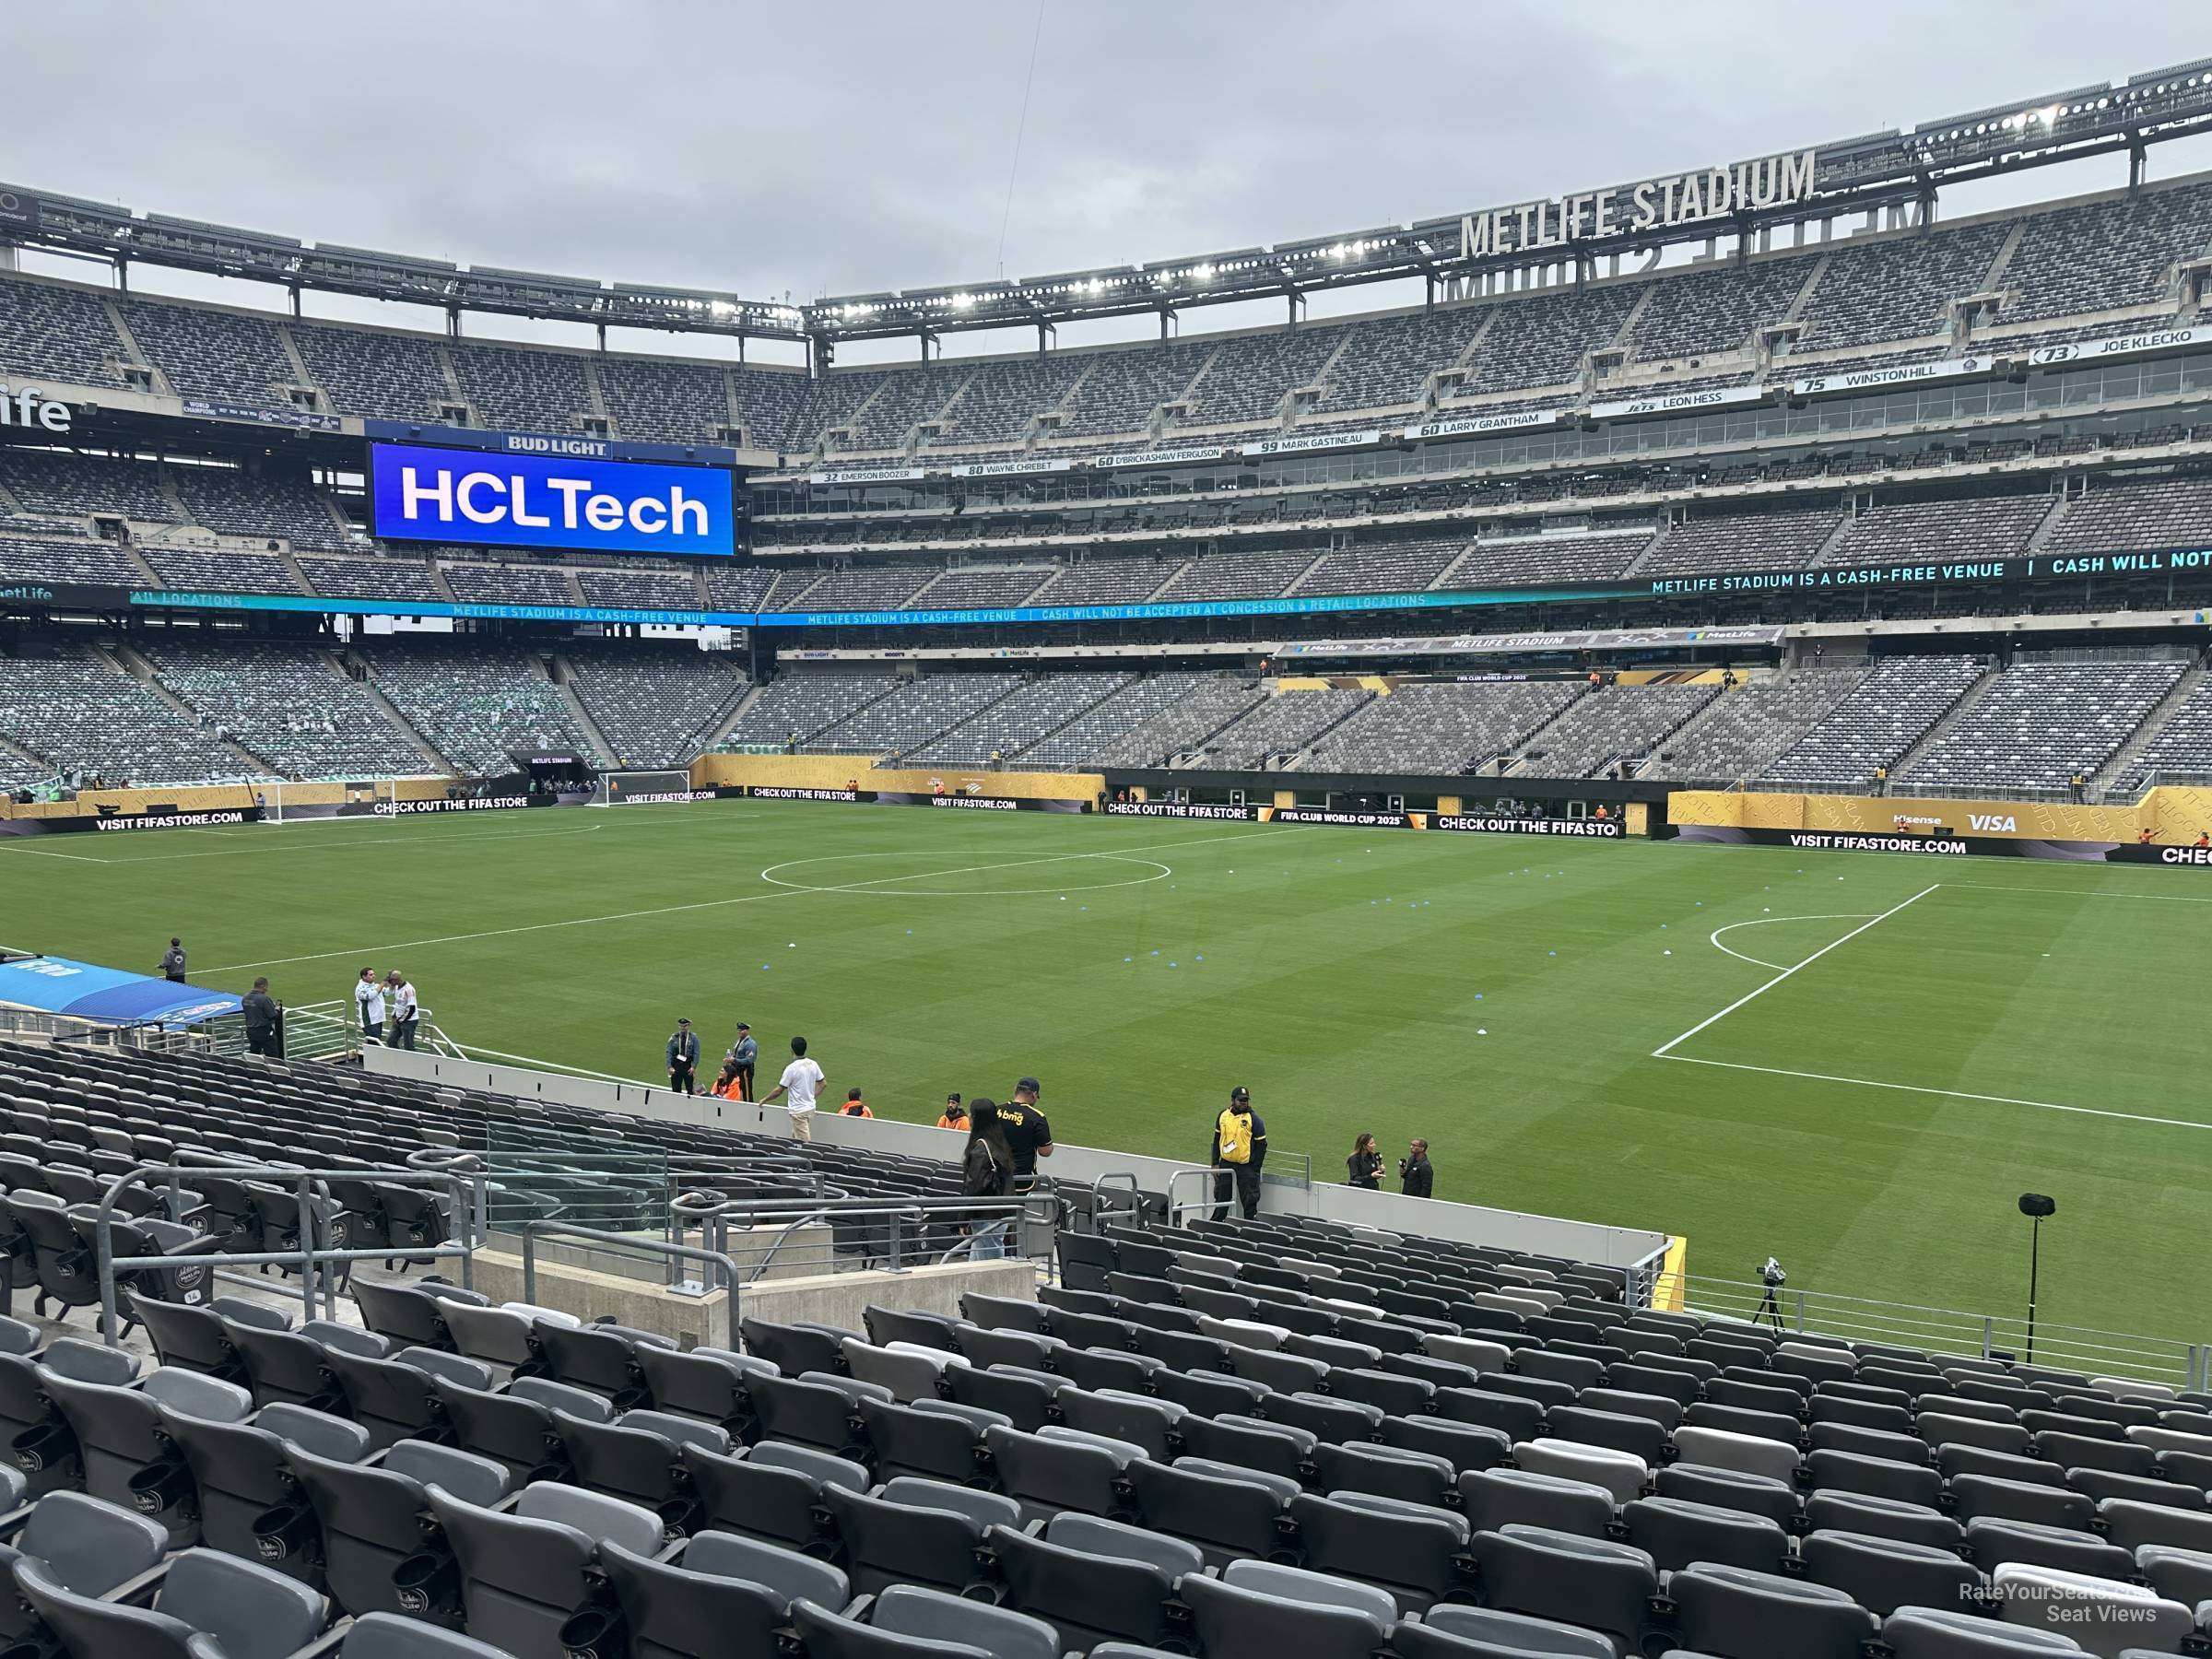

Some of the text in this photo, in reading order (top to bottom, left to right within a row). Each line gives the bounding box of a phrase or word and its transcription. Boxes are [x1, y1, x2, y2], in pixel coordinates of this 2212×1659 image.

[1461, 190, 1617, 258] METLIFE
[1632, 150, 1816, 228] STADIUM
[2043, 330, 2192, 360] 73 JOE KLECKO
[1804, 365, 1936, 392] 75 WINSTON HILL
[1663, 396, 1691, 409] LEON
[1693, 392, 1723, 405] HESS
[1420, 413, 1539, 436] 60 LARRY GRANTHAM
[508, 436, 606, 457] BUD LIGHT
[1261, 434, 1362, 453] 99 MARK GASTINEAU
[1098, 448, 1219, 466] 60 D'BRICKASHAW FERGUSON
[824, 470, 910, 482] 32 EMERSON BOOZER
[969, 462, 1052, 476] 80 WAYNE CHREBET
[402, 466, 708, 535] HCLTech
[1653, 550, 2212, 594] METLIFE STADIUM IS A CASH-FREE VENUE CASH WILL NOT
[161, 593, 241, 606] LOCATIONS
[453, 605, 707, 624] METLIFE STADIUM IS A CASH-FREE VENUE
[808, 614, 851, 624] METLIFE
[853, 613, 897, 624] STADIUM
[900, 613, 909, 623] IS
[912, 613, 920, 622] A
[922, 611, 979, 622] CASH-FREE
[982, 610, 1017, 621] VENUE
[1041, 609, 1069, 620] CASH
[1071, 607, 1099, 619] WILL
[1101, 606, 1124, 618] NOT
[1127, 606, 1141, 617] BE
[1143, 604, 1200, 617] ACCEPTED
[1204, 603, 1218, 613] AT
[1220, 599, 1294, 614] CONCESSION
[1310, 597, 1353, 612] RETAIL
[1356, 594, 1425, 608] LOCATIONS
[1452, 636, 1565, 648] METLIFE STADIUM
[1707, 629, 1756, 639] MetLife
[1311, 644, 1347, 653] MetLife
[625, 791, 715, 803] VISIT FIFASTORE.COM
[754, 788, 855, 801] CHECK OUT THE FIFA STORE
[374, 797, 527, 814] CHECK OUT THE FIFA STORE
[932, 798, 1017, 809] VISIT FIFASTORE.COM
[1108, 803, 1247, 819] CHECK OUT THE FIFA STORE
[97, 812, 243, 830] VISIT FIFASTORE.COM
[1281, 812, 1299, 820] FIFA
[1300, 813, 1322, 822] CLUB
[1324, 814, 1357, 823] WORLD
[1358, 815, 1375, 824] CUP
[1893, 815, 1941, 825] Hisense
[1966, 814, 2016, 832] VISA
[1439, 818, 1618, 836] CHECK OUT THE FIFA STO
[1790, 835, 1966, 854] VISIT FIFASTORE.COM
[2161, 847, 2212, 865] CHE
[1003, 1110, 1023, 1126] bmg
[187, 1292, 198, 1300] 14
